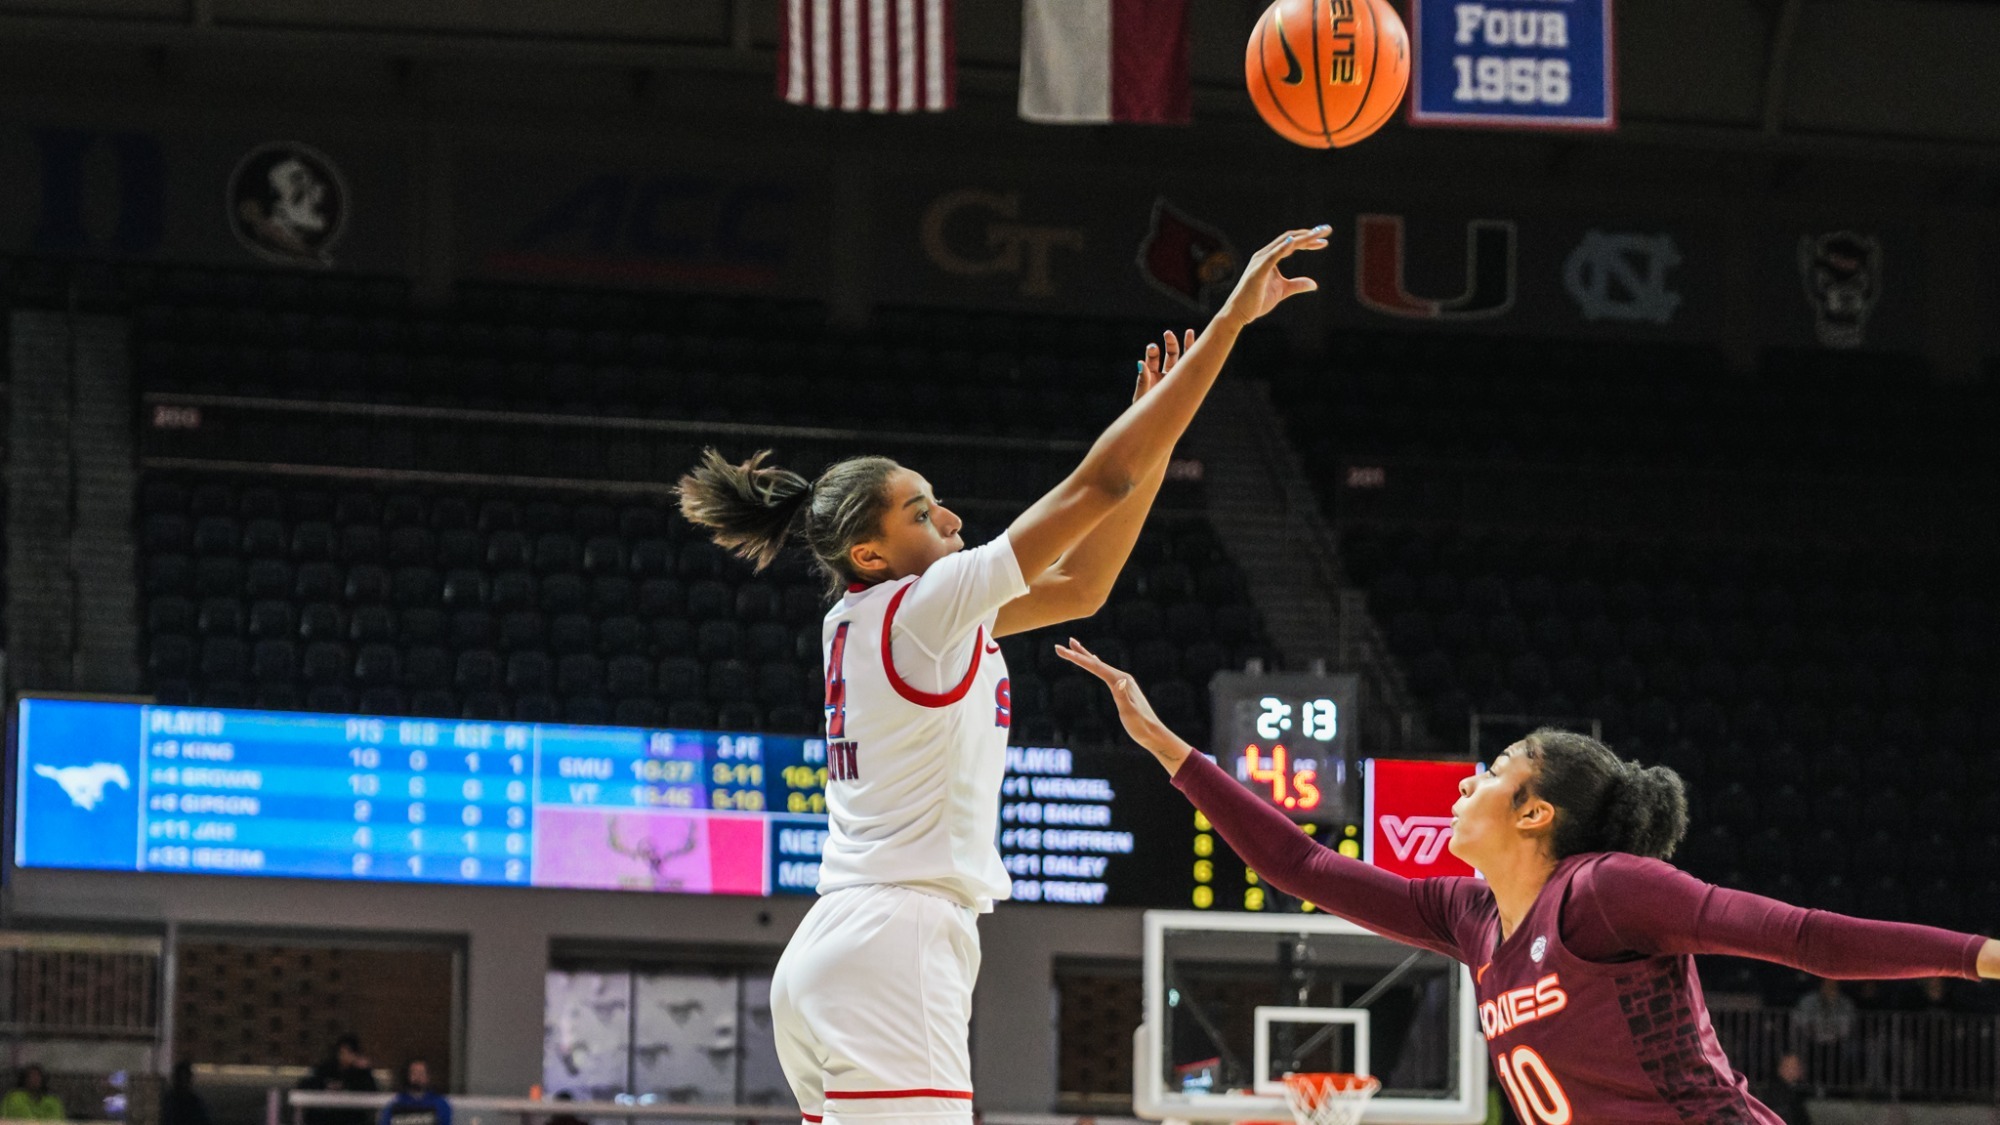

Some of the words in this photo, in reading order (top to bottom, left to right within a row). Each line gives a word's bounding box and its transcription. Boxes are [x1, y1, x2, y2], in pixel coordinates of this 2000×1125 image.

[1454, 5, 1569, 48] FOUR
[1330, 0, 1355, 84] ELITE
[1453, 56, 1572, 106] 1956
[151, 709, 224, 736] PLAYER
[1257, 697, 1337, 741] 2:13
[346, 718, 384, 744] PTS
[181, 742, 235, 761] KING
[349, 748, 380, 769] 10
[409, 750, 427, 771] 0
[465, 752, 480, 773] 1
[509, 753, 523, 775] 1
[559, 757, 613, 779] SMU
[181, 767, 263, 790] BROWN
[1245, 743, 1320, 809] 4.5
[569, 782, 599, 804] VT
[786, 791, 831, 814] 8-1
[1002, 776, 1029, 798] #1
[1031, 777, 1115, 801] WENZEL
[1002, 802, 1043, 824] #10
[1043, 803, 1111, 827] BAKER
[353, 826, 372, 849] 4
[408, 828, 422, 850] 1
[461, 831, 478, 853] 1
[408, 855, 422, 877] 1
[505, 858, 523, 881] 2
[1012, 879, 1042, 901] 30
[1498, 1044, 1573, 1125] 10
